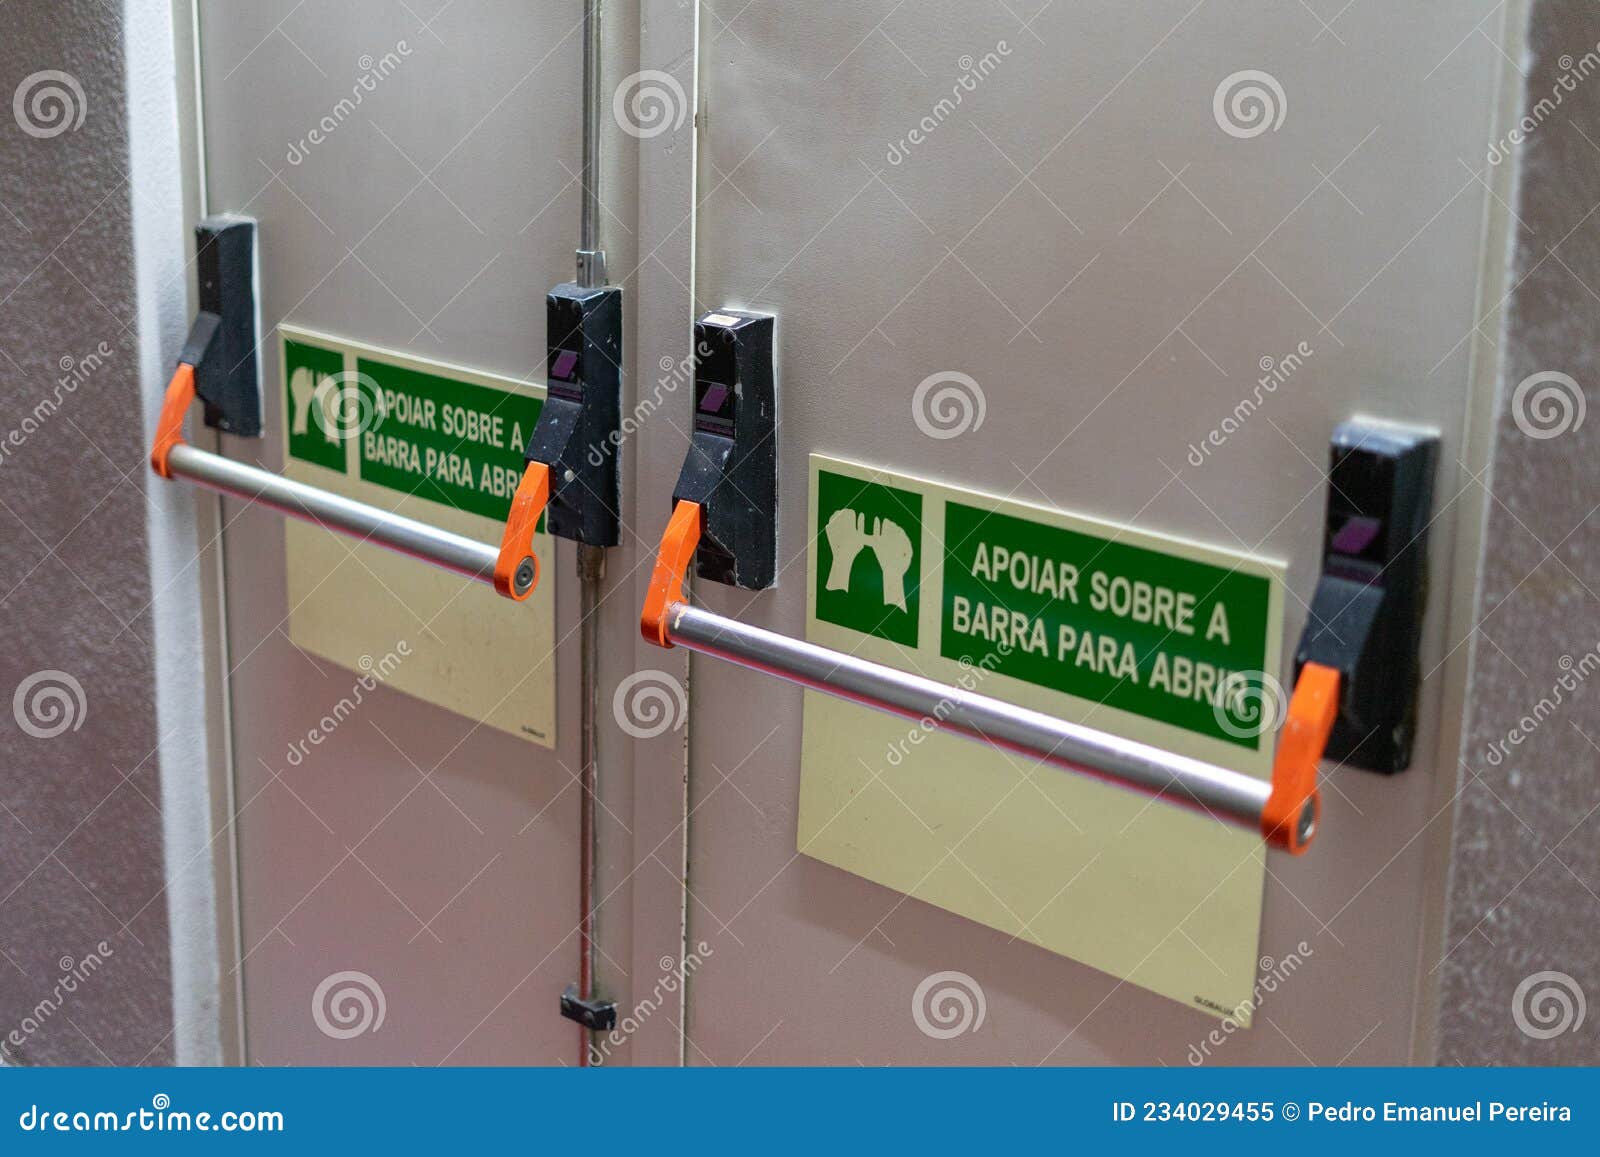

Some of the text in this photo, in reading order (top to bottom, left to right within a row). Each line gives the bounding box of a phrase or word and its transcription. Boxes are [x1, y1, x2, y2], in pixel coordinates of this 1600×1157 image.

[374, 388, 524, 453] APOIAR SOBRE A
[364, 430, 523, 500] BARRA PARA ABR
[971, 542, 1230, 645] APOIAR SOBRE A
[953, 595, 1248, 716] BARRA PARA ABRIR
